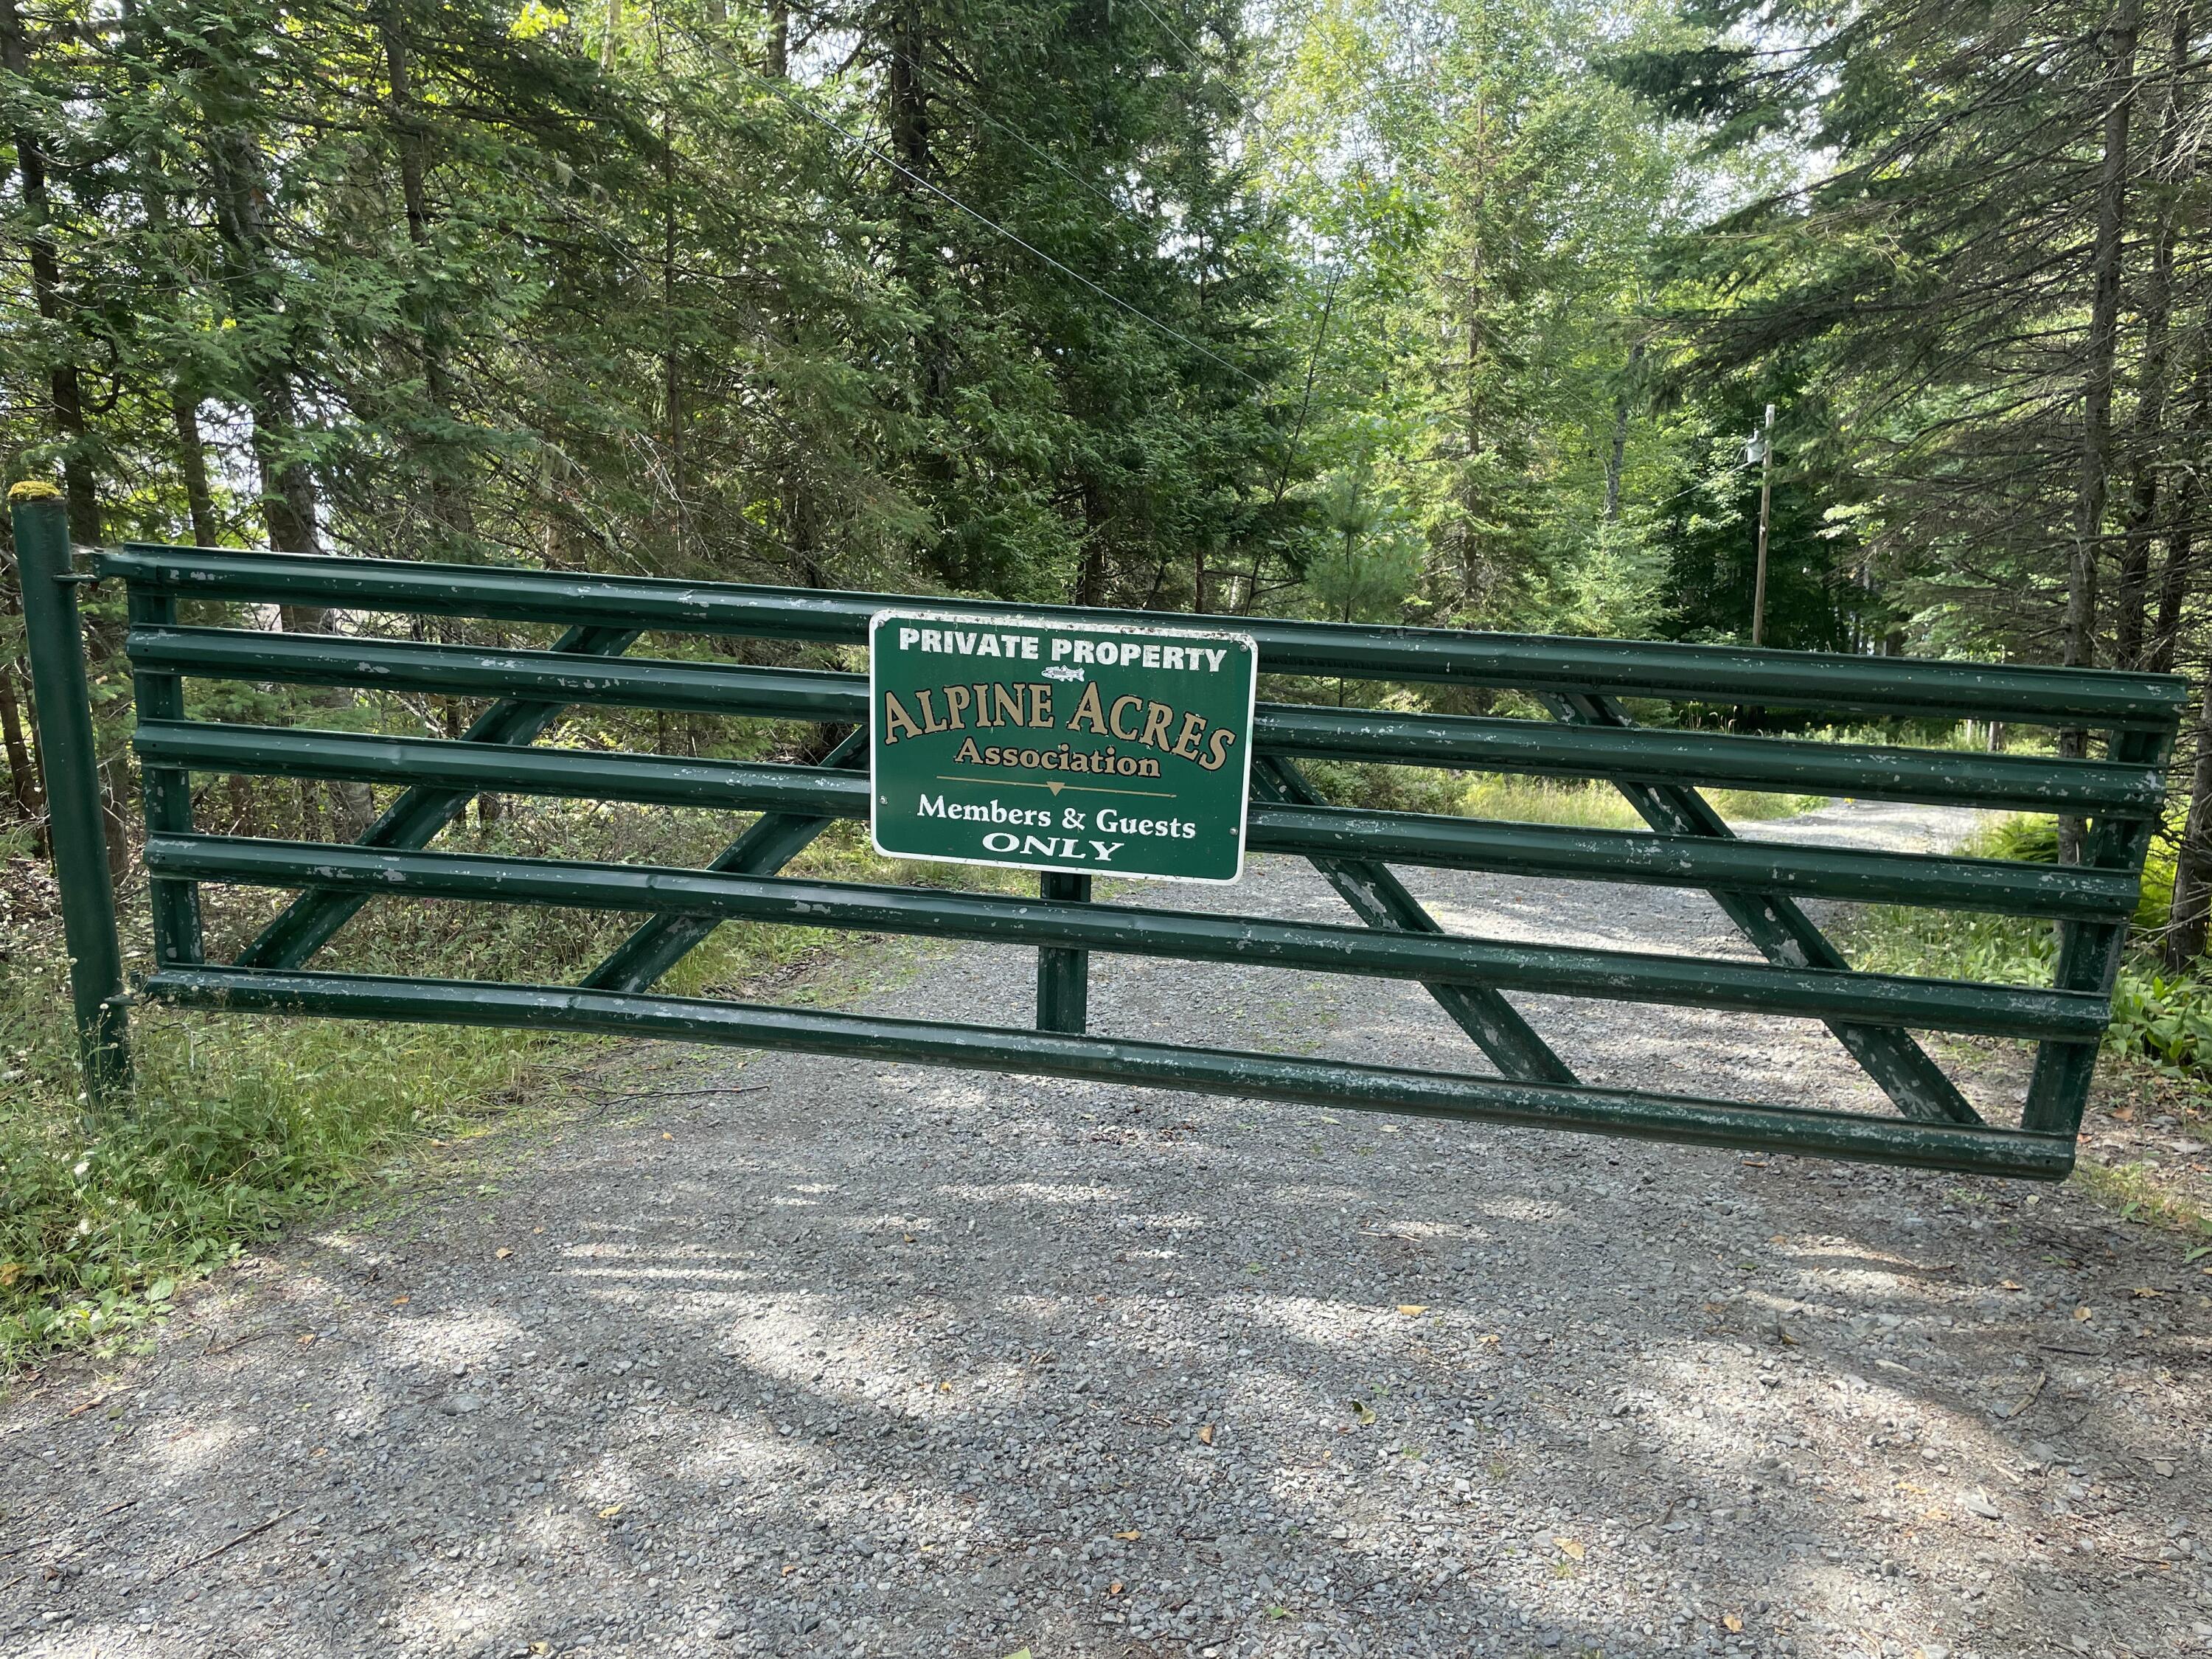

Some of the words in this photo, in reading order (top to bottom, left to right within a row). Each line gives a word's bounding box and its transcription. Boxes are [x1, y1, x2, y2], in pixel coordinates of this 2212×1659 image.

[899, 627, 1039, 660] PRIVATE
[1051, 638, 1228, 672] PROPERTY
[884, 681, 1054, 745] ALPINE
[1068, 681, 1237, 771] ACRES
[953, 736, 1161, 778] Association
[917, 793, 1051, 829] Members
[1062, 808, 1085, 831] &
[1096, 809, 1196, 839] Guests
[982, 832, 1124, 861] ONLY
